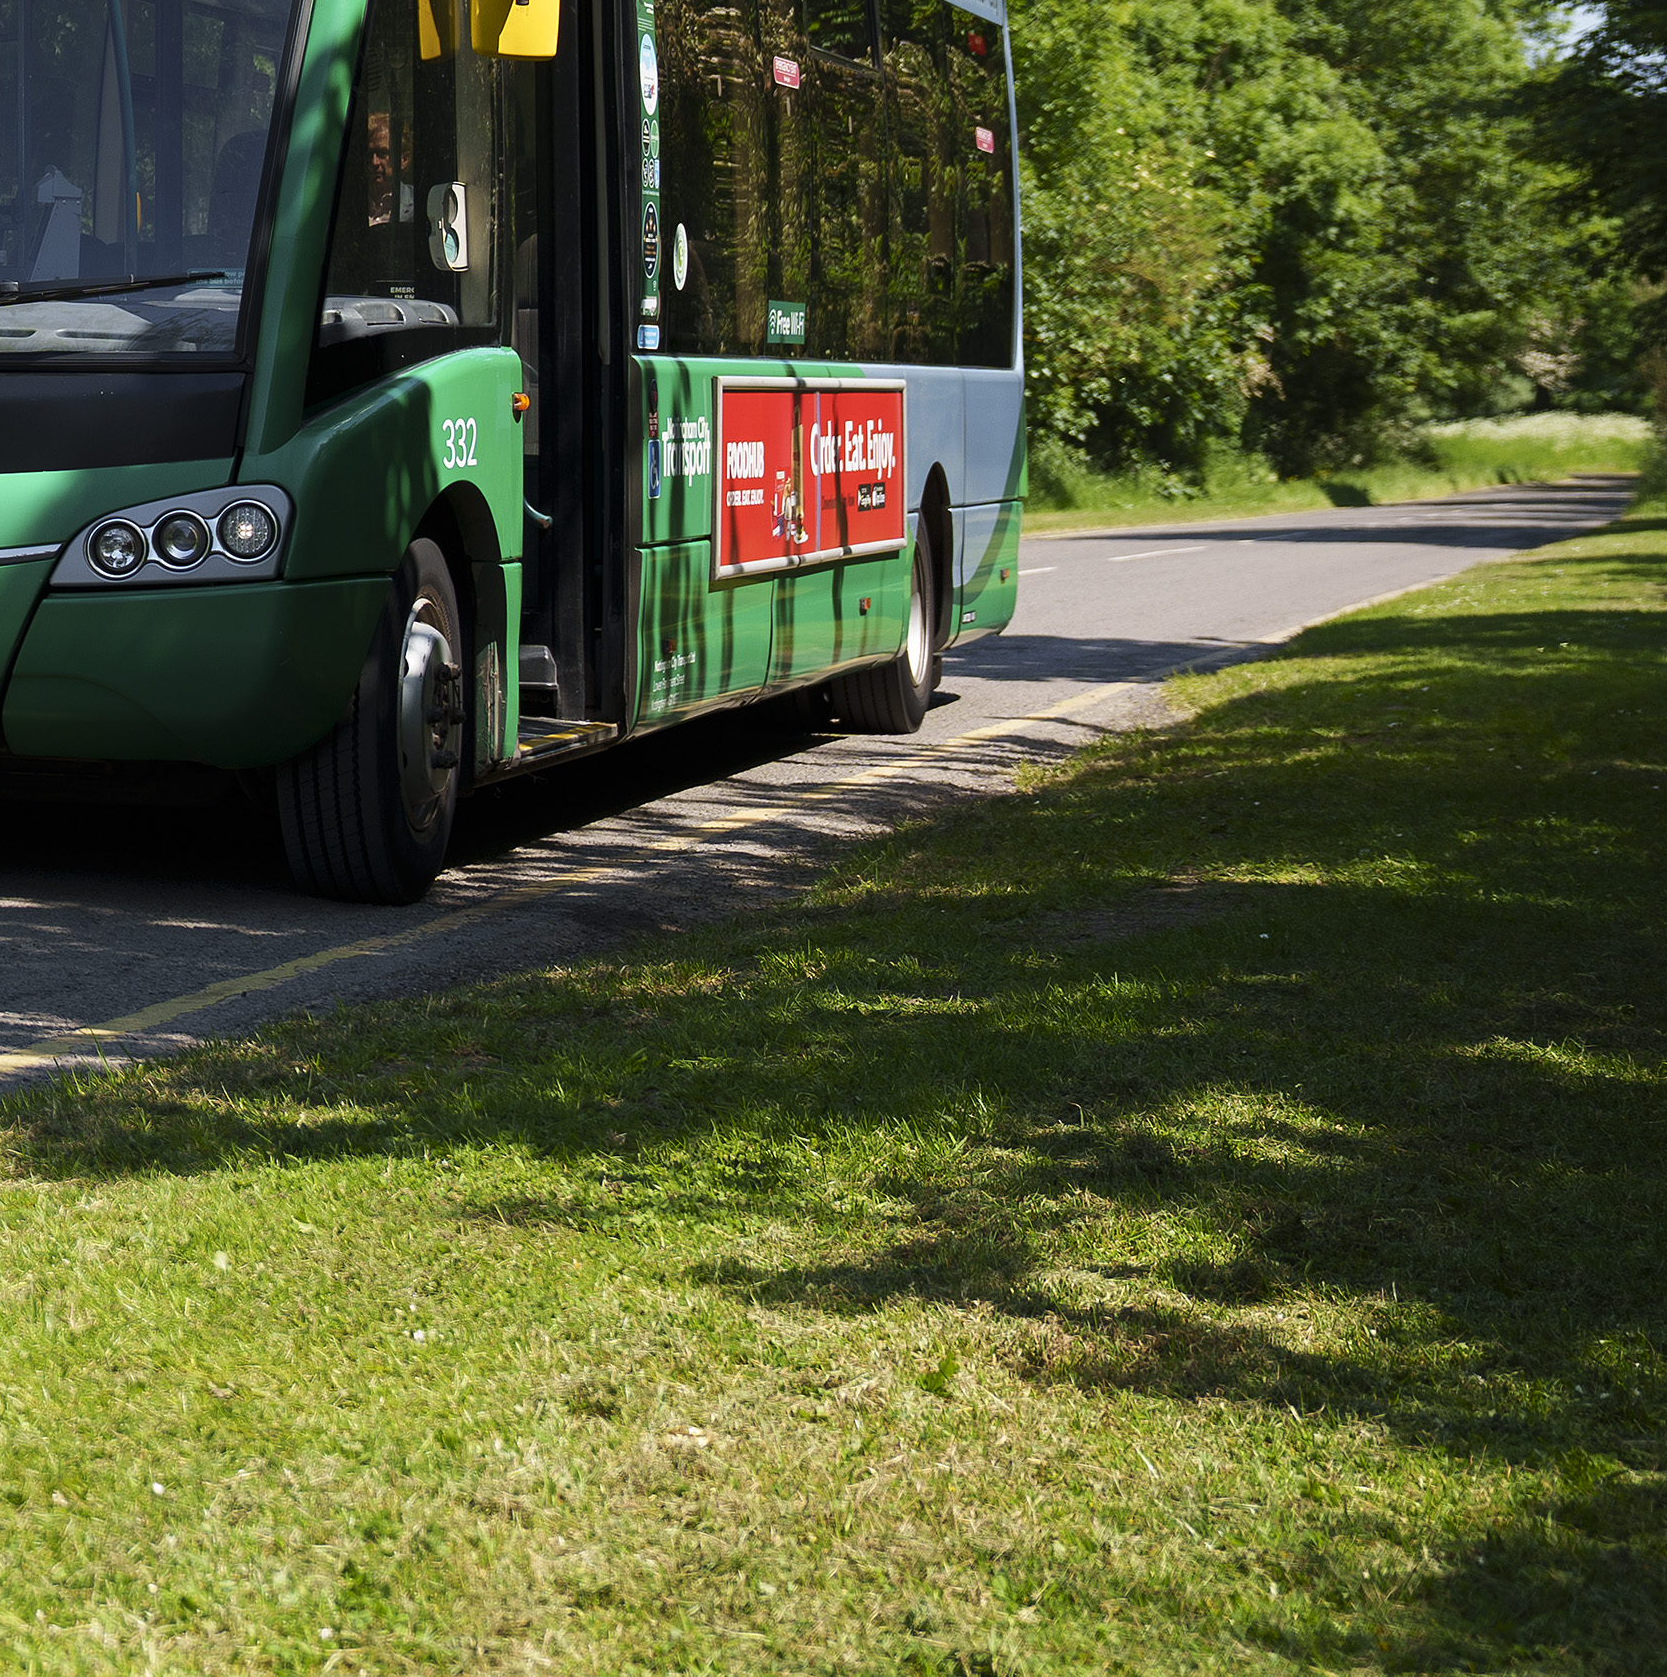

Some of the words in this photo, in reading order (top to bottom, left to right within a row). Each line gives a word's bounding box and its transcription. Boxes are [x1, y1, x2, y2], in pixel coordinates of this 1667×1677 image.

[776, 310, 790, 335] Free
[790, 311, 805, 336] Wi-Fi
[442, 417, 477, 469] 332
[662, 430, 710, 487] Transport
[726, 441, 765, 479] FOODHUB
[845, 420, 866, 472] Eat.
[867, 418, 896, 480] Enjoy.
